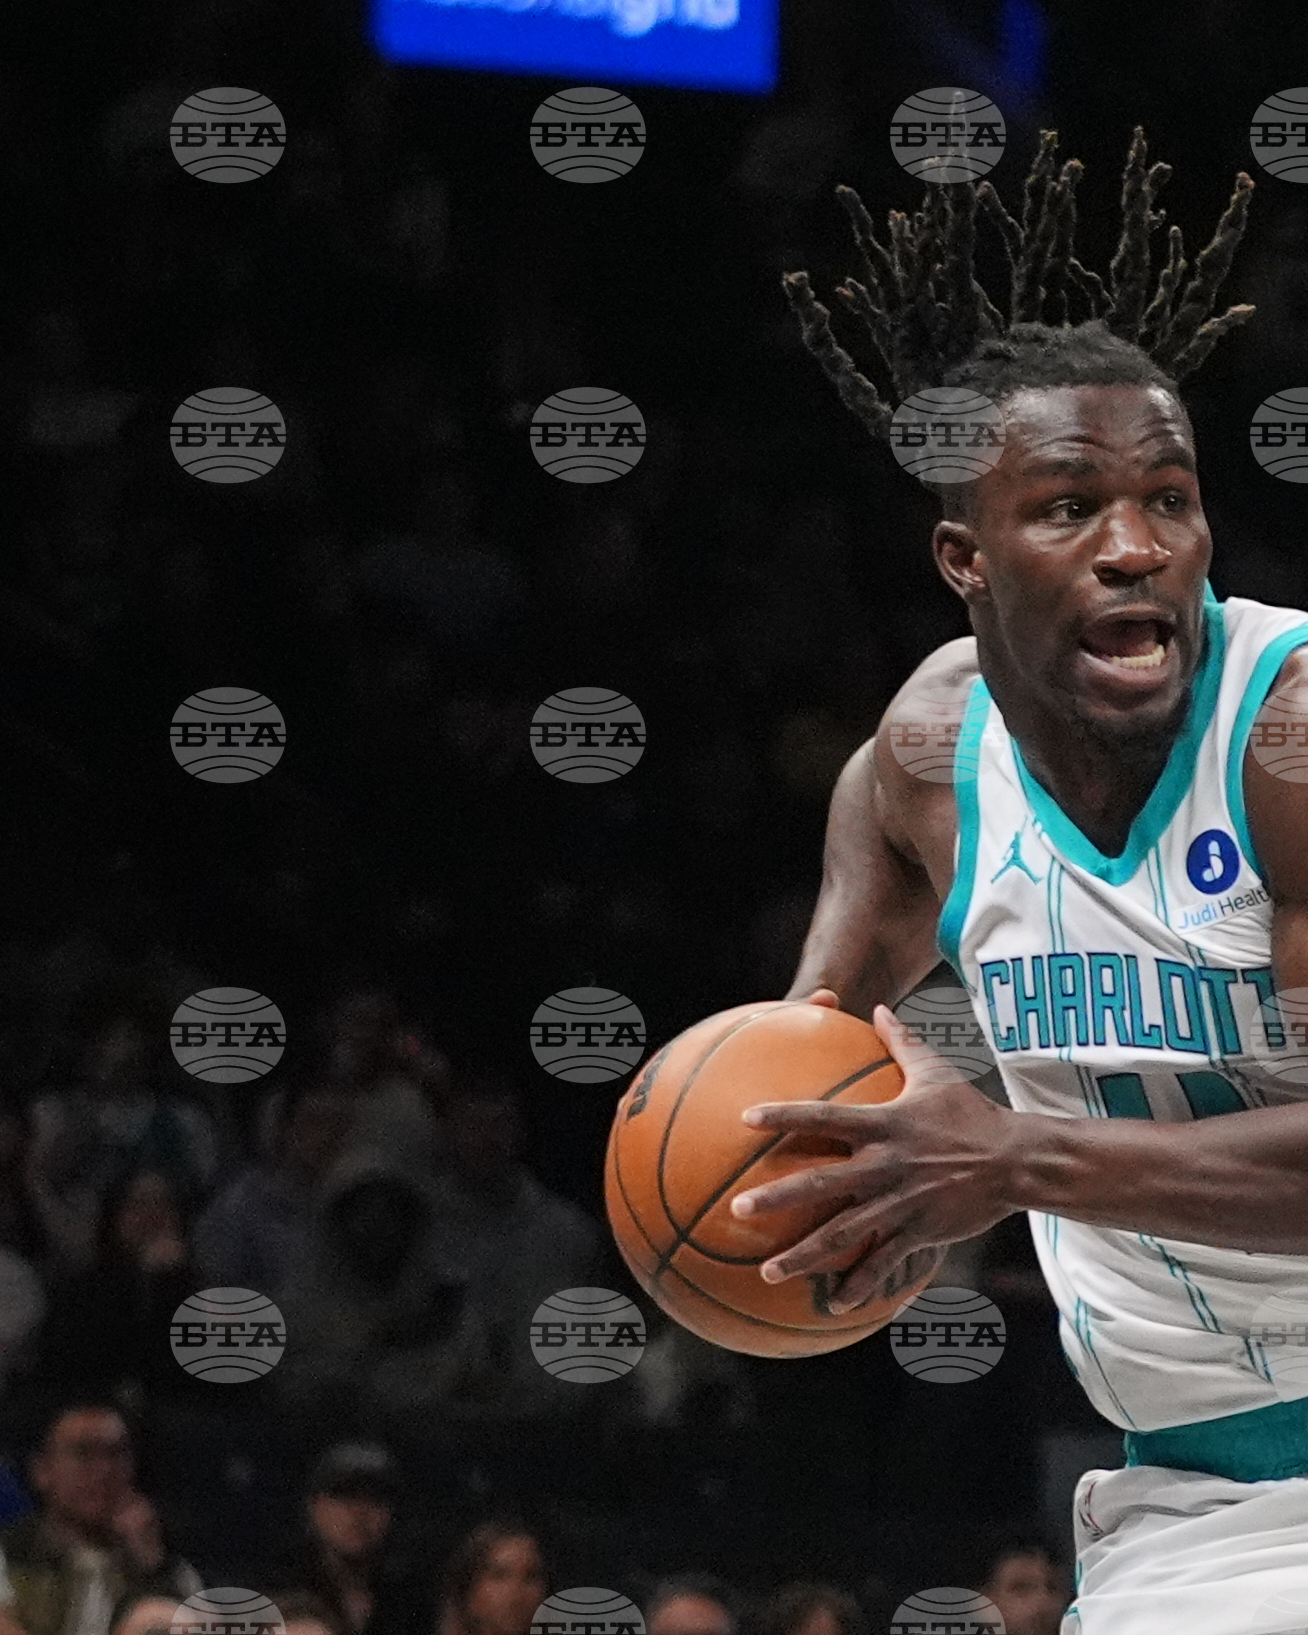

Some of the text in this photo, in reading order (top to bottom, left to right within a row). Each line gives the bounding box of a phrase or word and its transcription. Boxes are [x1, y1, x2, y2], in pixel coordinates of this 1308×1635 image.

[1178, 889, 1270, 929] Judi Healt
[981, 952, 1287, 1052] CHARLOTT
